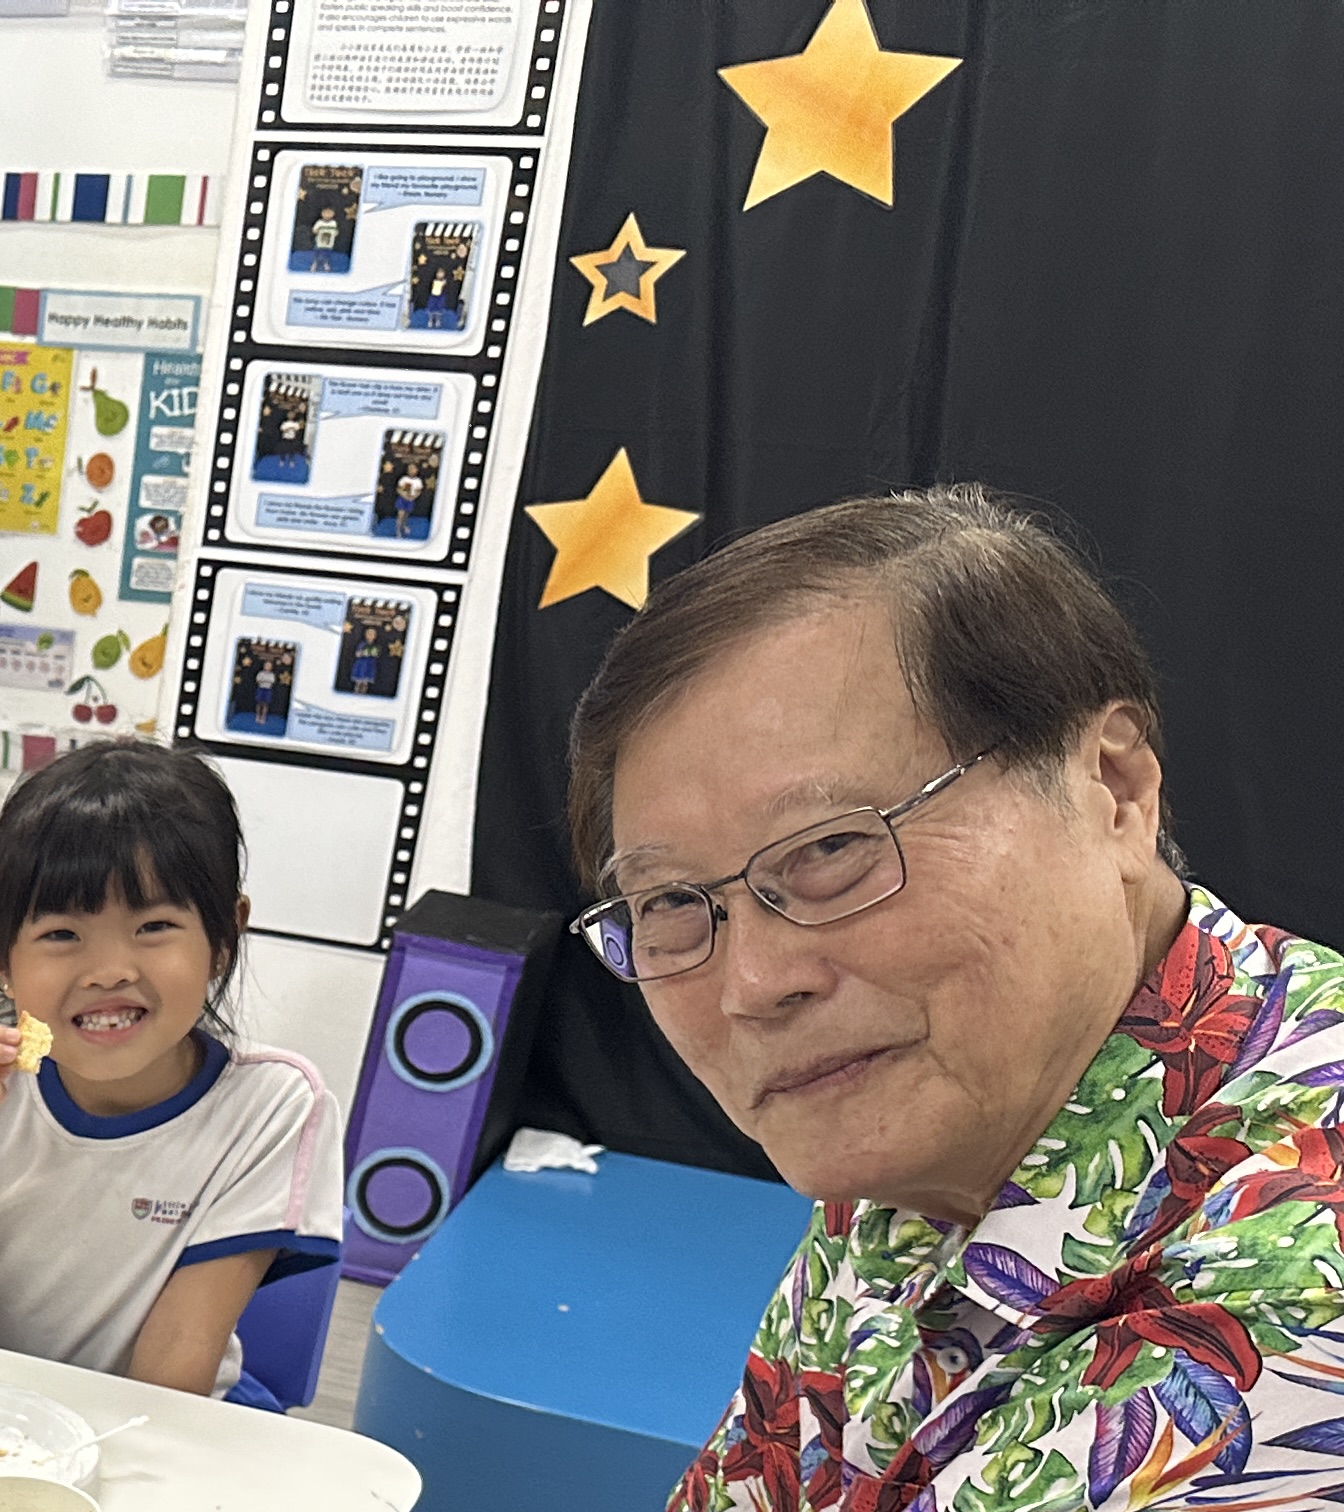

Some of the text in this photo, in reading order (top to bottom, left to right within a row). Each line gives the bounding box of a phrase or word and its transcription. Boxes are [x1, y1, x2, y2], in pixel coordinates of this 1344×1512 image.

[47, 312, 188, 331] Happy Healthy Habits
[31, 373, 48, 394] G
[20, 484, 35, 504] Z
